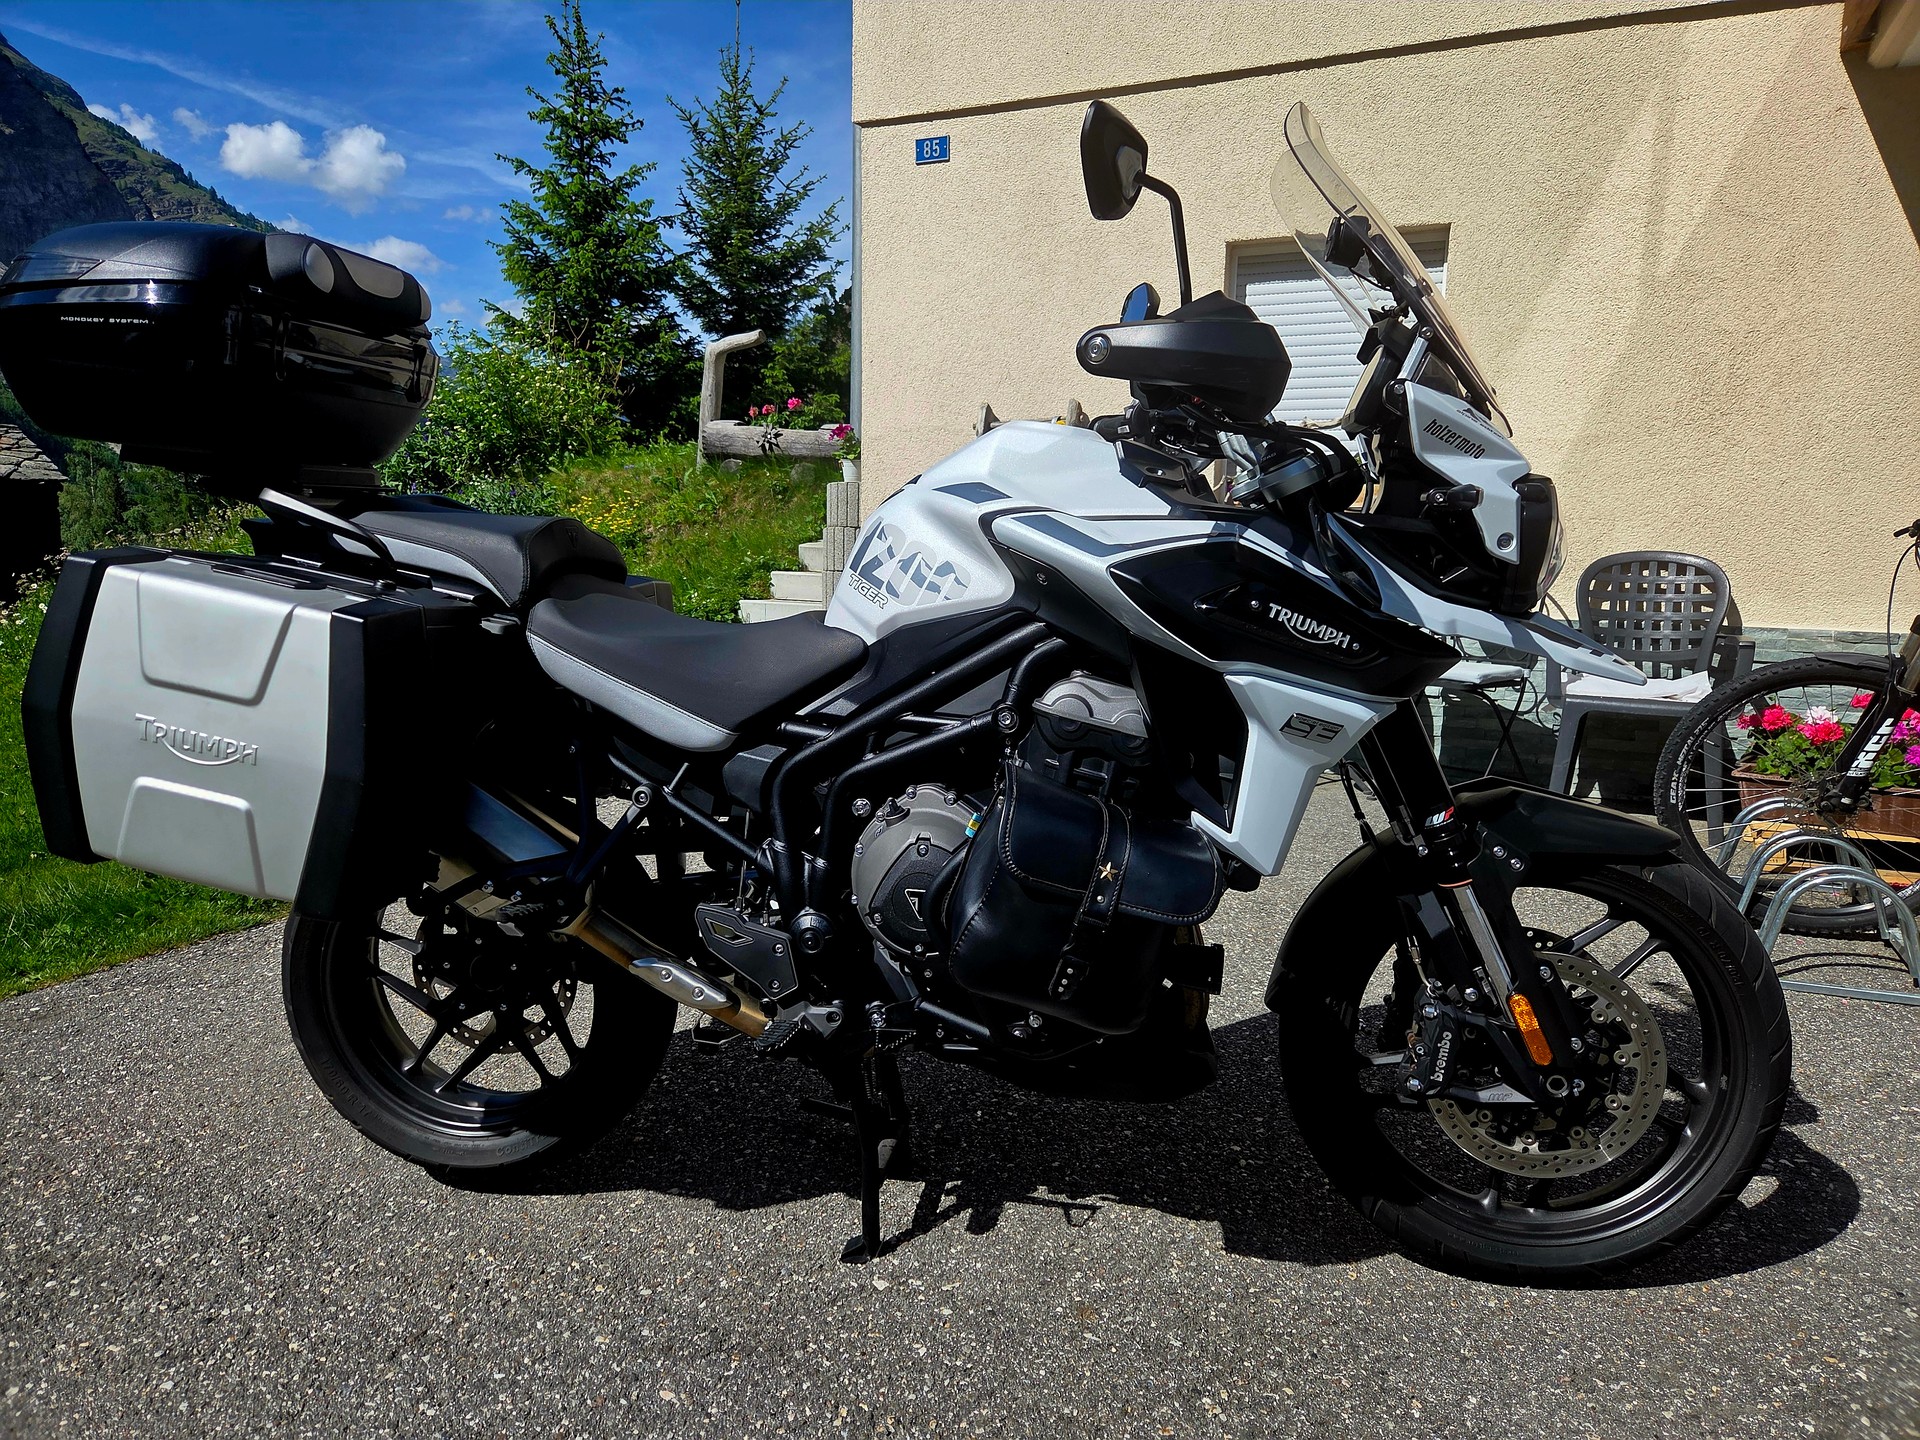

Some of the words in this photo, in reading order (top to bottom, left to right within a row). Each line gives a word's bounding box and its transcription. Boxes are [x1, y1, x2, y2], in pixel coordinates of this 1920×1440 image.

[924, 139, 940, 158] 85
[1422, 418, 1487, 460] holzermoto
[848, 515, 972, 607] 1200
[848, 573, 889, 610] TIGER
[1268, 602, 1351, 649] TRIUMPH
[134, 712, 259, 767] TRIUMPH
[1281, 715, 1343, 745] SE
[1430, 1031, 1452, 1082] brembo
